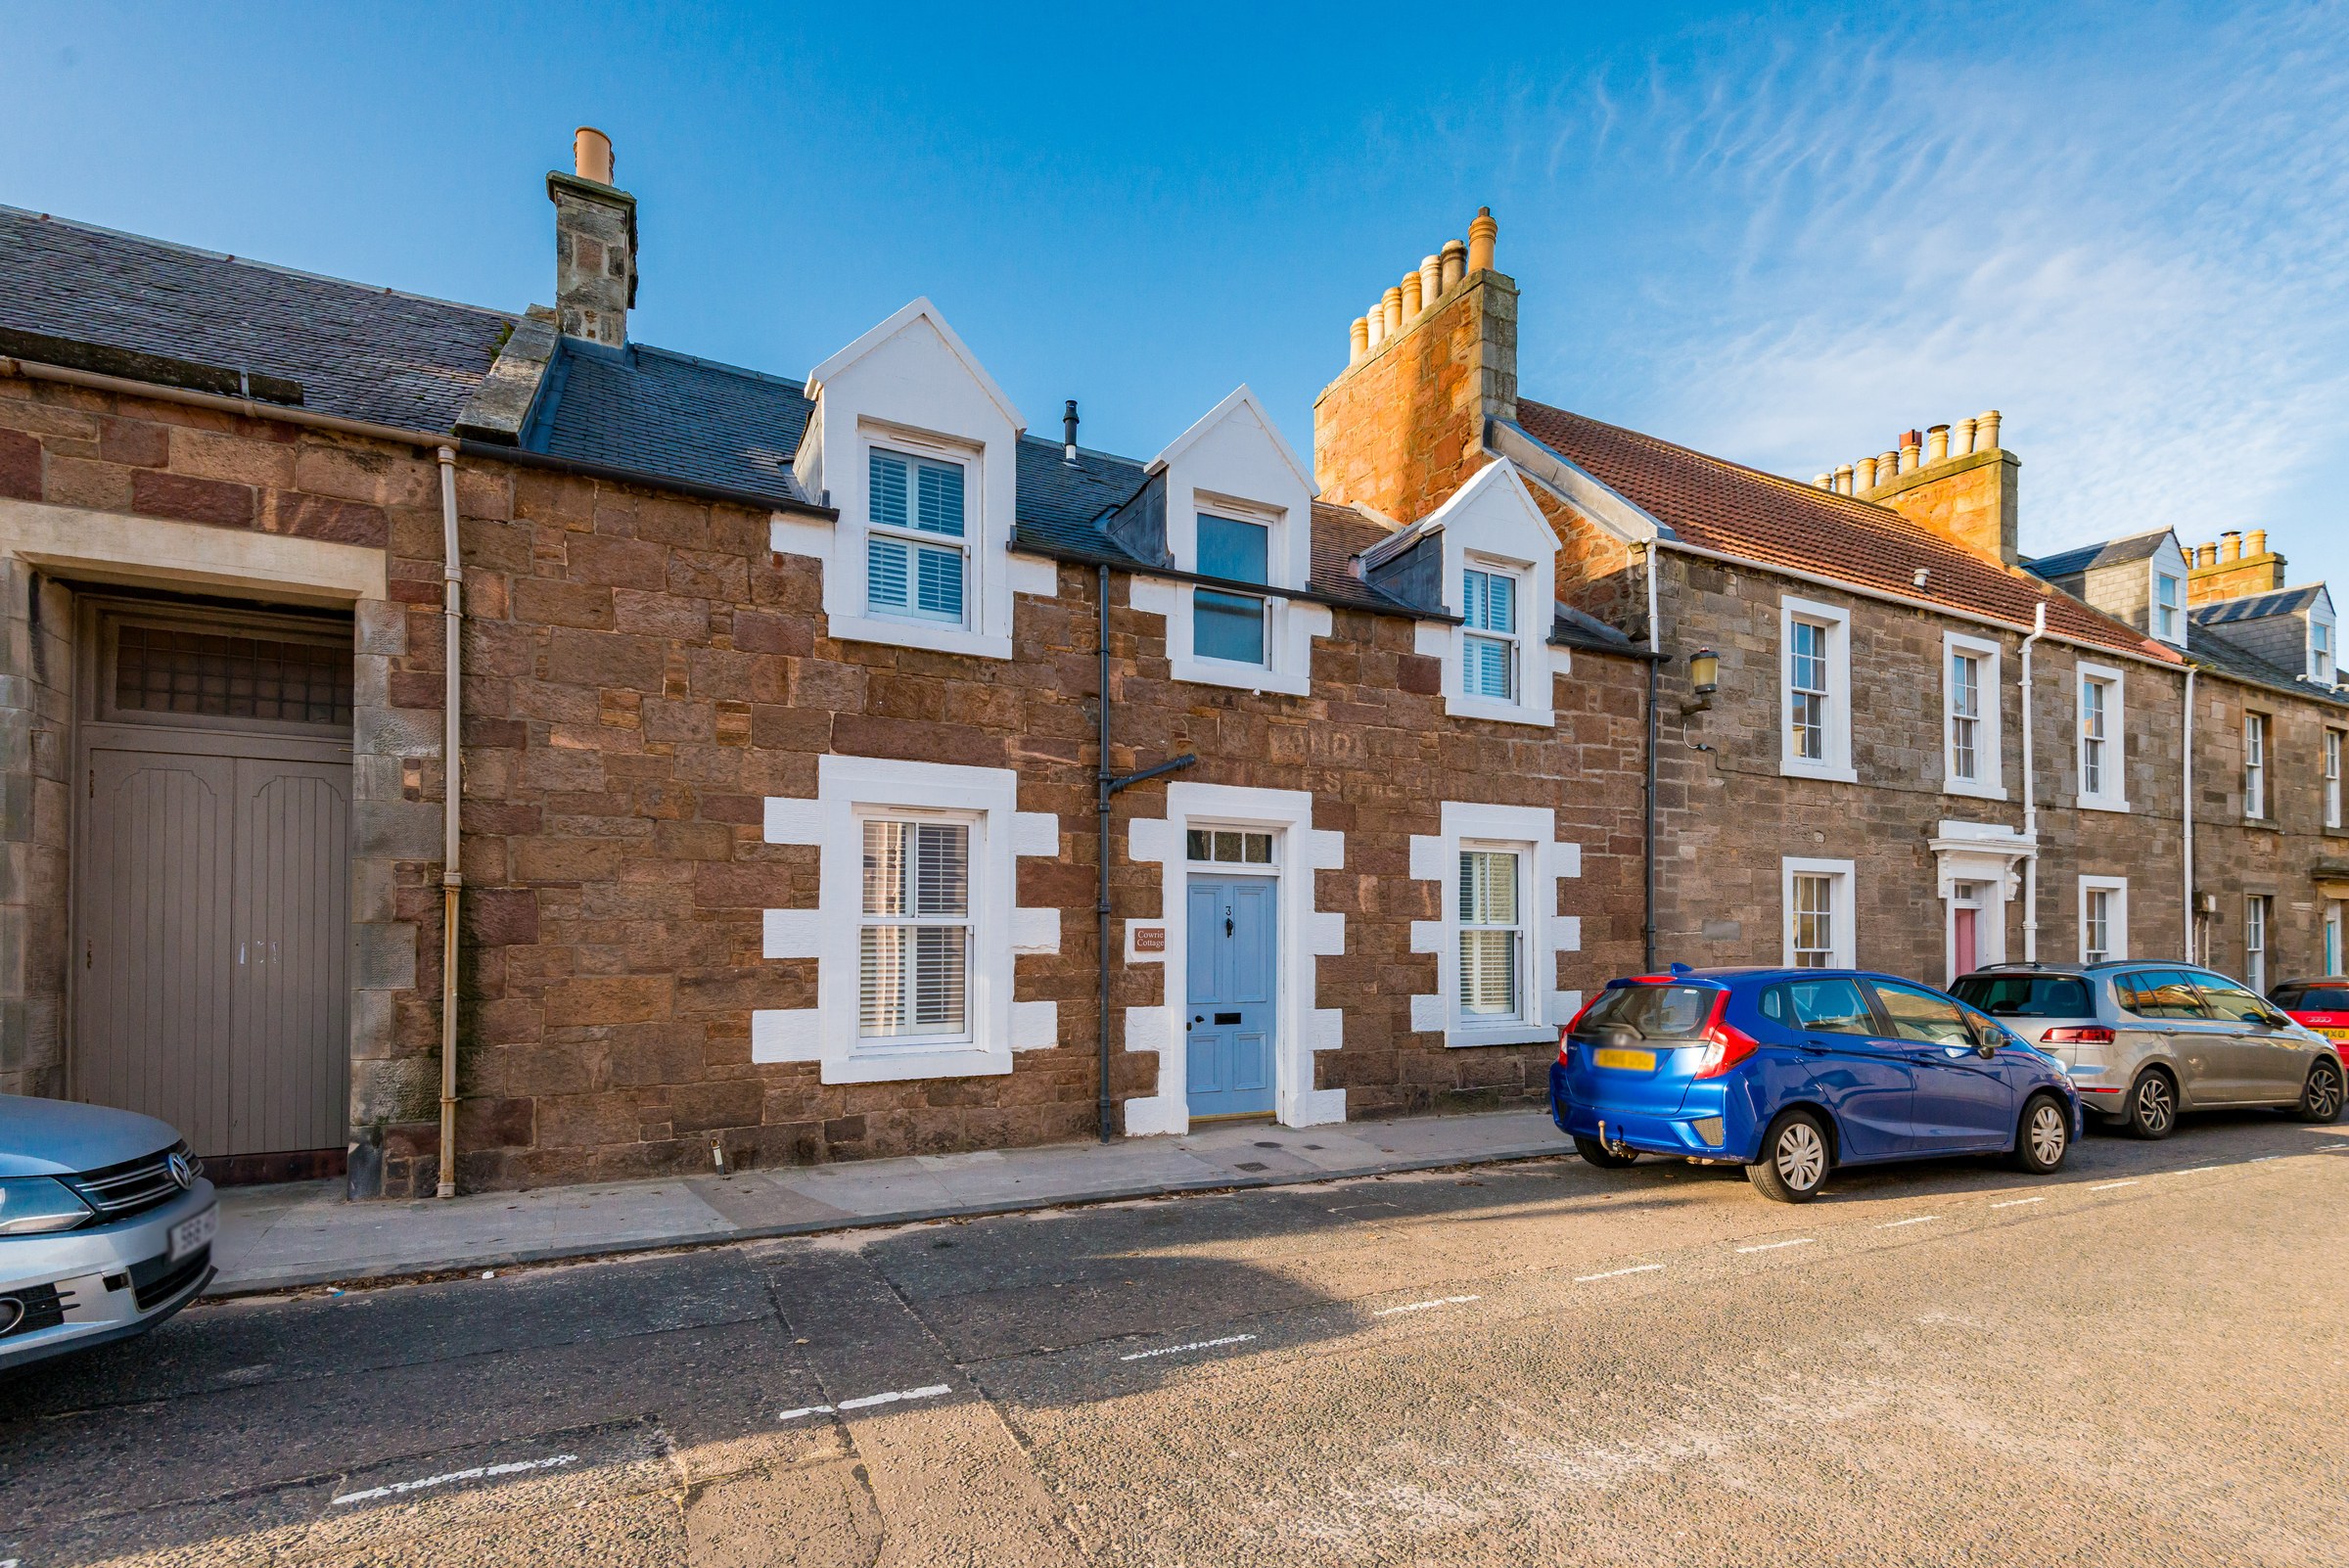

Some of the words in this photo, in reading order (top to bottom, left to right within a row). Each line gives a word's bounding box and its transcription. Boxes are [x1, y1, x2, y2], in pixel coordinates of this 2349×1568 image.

[1225, 905, 1232, 916] 3
[1137, 930, 1164, 939] Cowrie
[1136, 939, 1165, 948] Cottage
